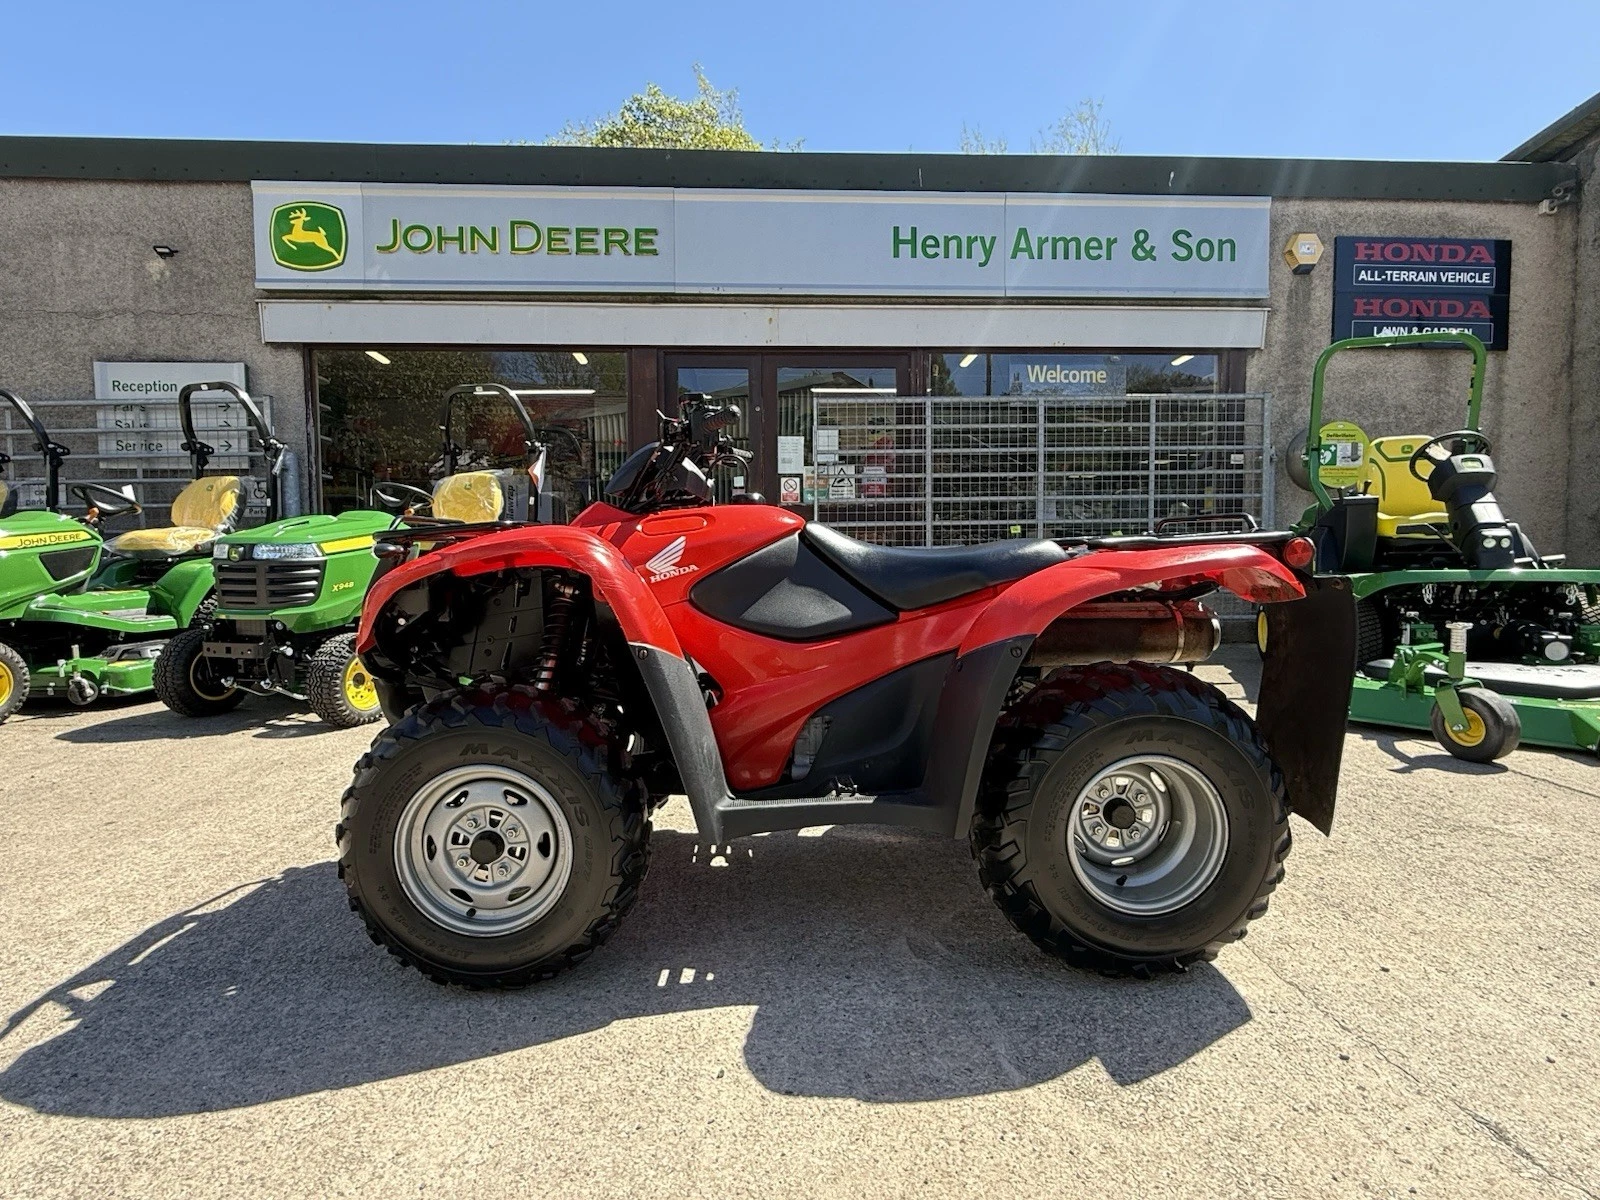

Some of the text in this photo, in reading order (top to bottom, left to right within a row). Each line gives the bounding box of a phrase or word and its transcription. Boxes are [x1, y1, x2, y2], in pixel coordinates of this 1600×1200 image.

[376, 218, 659, 256] JOHN DEERE
[892, 226, 1236, 267] Henry Armer & Son
[1354, 242, 1495, 263] HONDA
[1358, 270, 1491, 284] ALL-TERRAIN VEHICLE
[1353, 298, 1493, 318] HONDA
[1027, 364, 1107, 384] Welcome
[112, 380, 178, 394] Reception
[115, 419, 149, 430] Sals
[17, 533, 81, 547] JOHN DEERE
[650, 564, 699, 583] HONDA
[331, 581, 354, 593] X948
[1125, 729, 1256, 809] MAXXIS
[459, 743, 590, 826] MAXXIS
